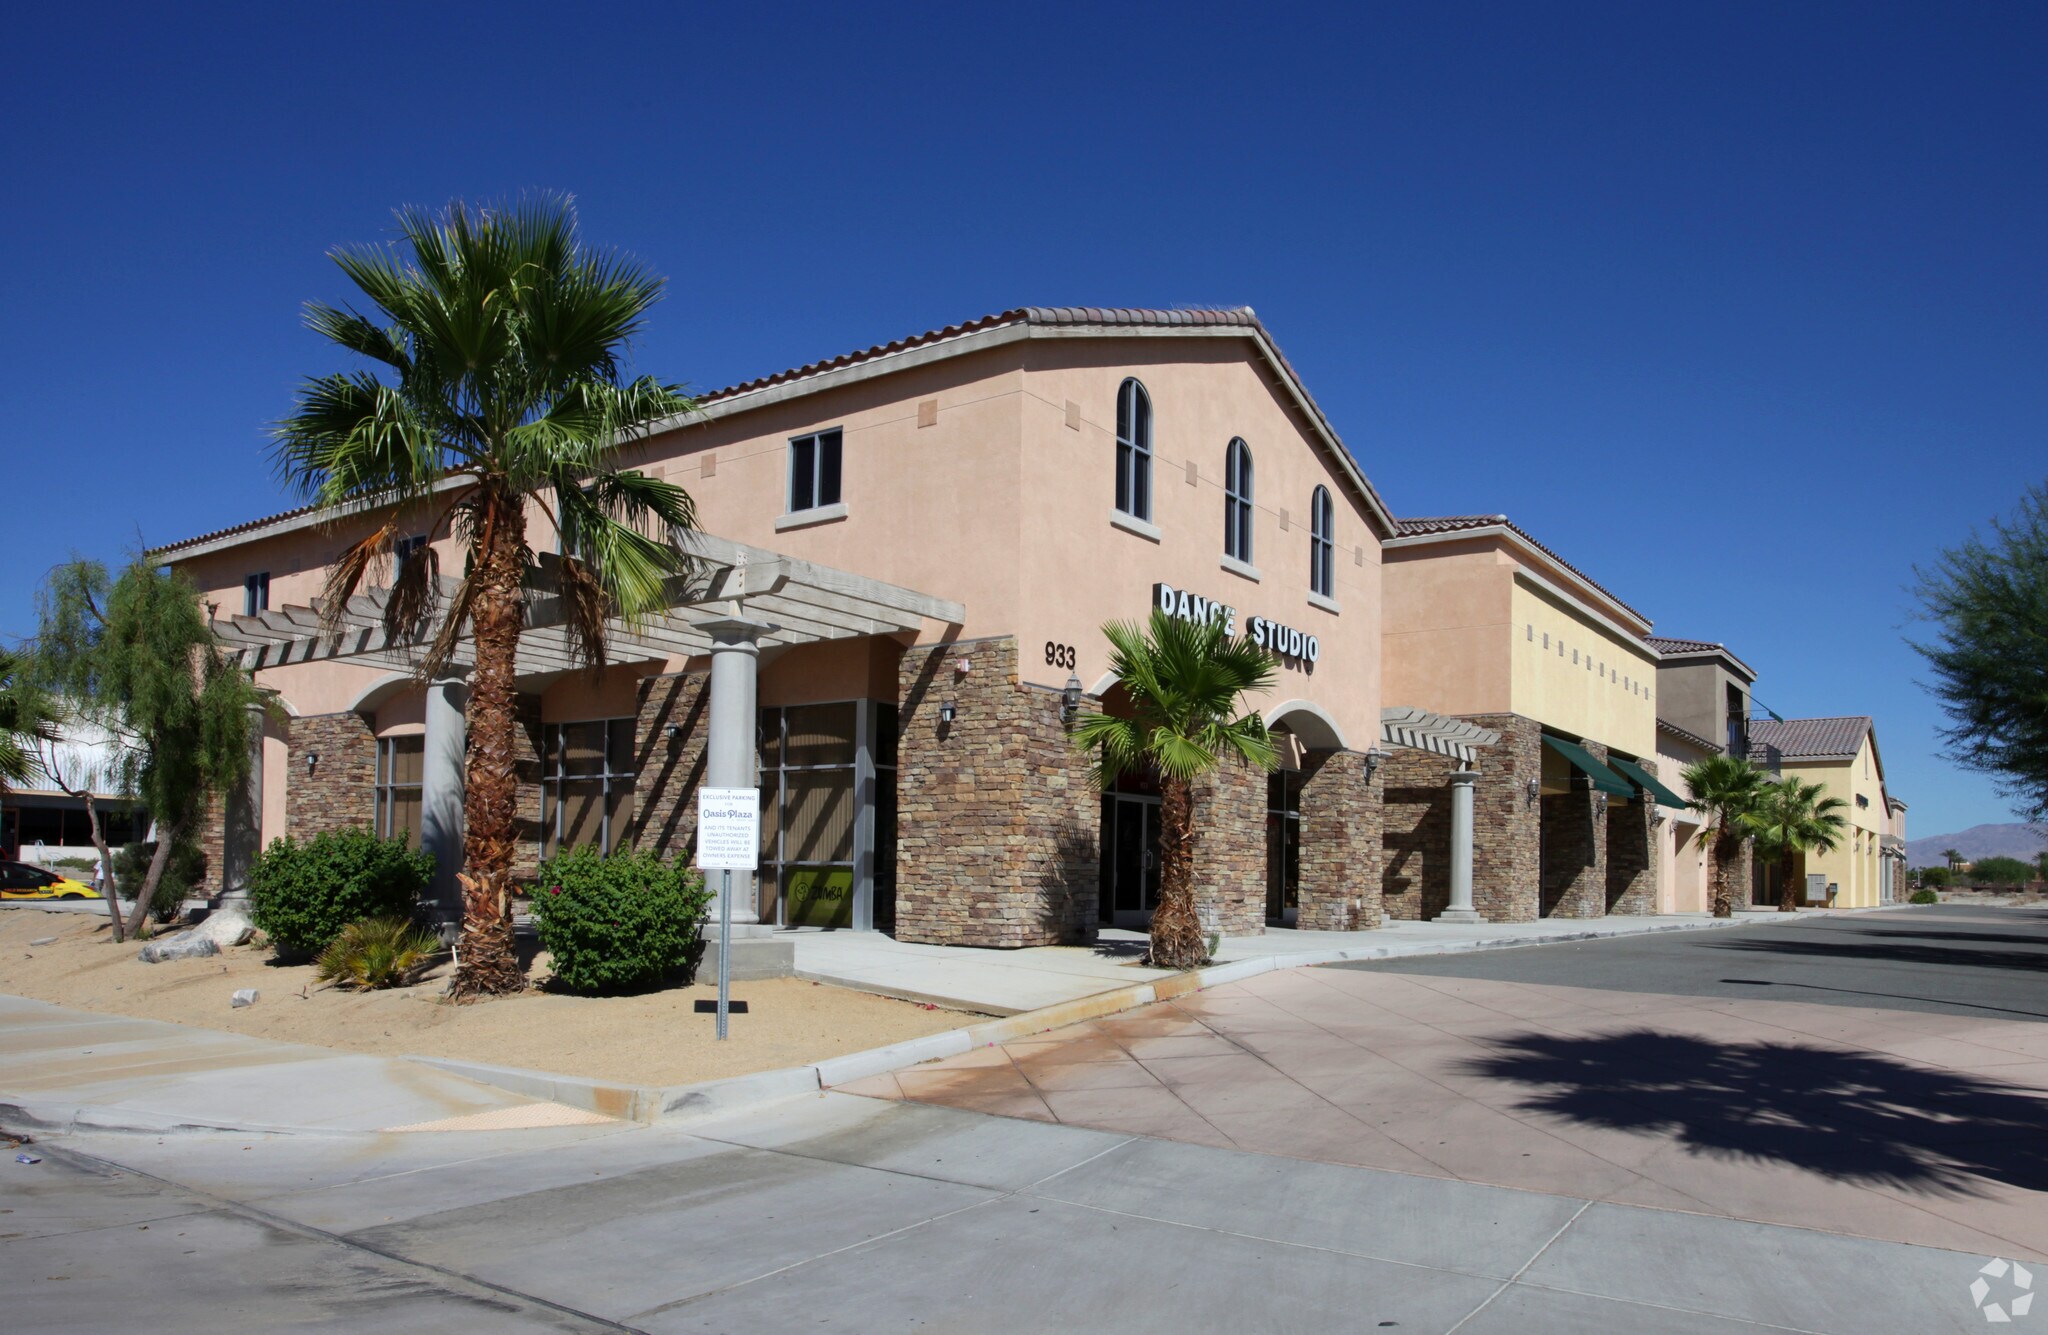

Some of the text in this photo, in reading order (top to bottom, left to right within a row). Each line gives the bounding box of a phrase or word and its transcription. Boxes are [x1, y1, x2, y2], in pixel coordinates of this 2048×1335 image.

[1153, 583, 1319, 663] DANCE STUDIO
[1045, 641, 1076, 670] 933
[703, 809, 753, 819] Oasis Plaza
[811, 885, 842, 901] ZUMBA
